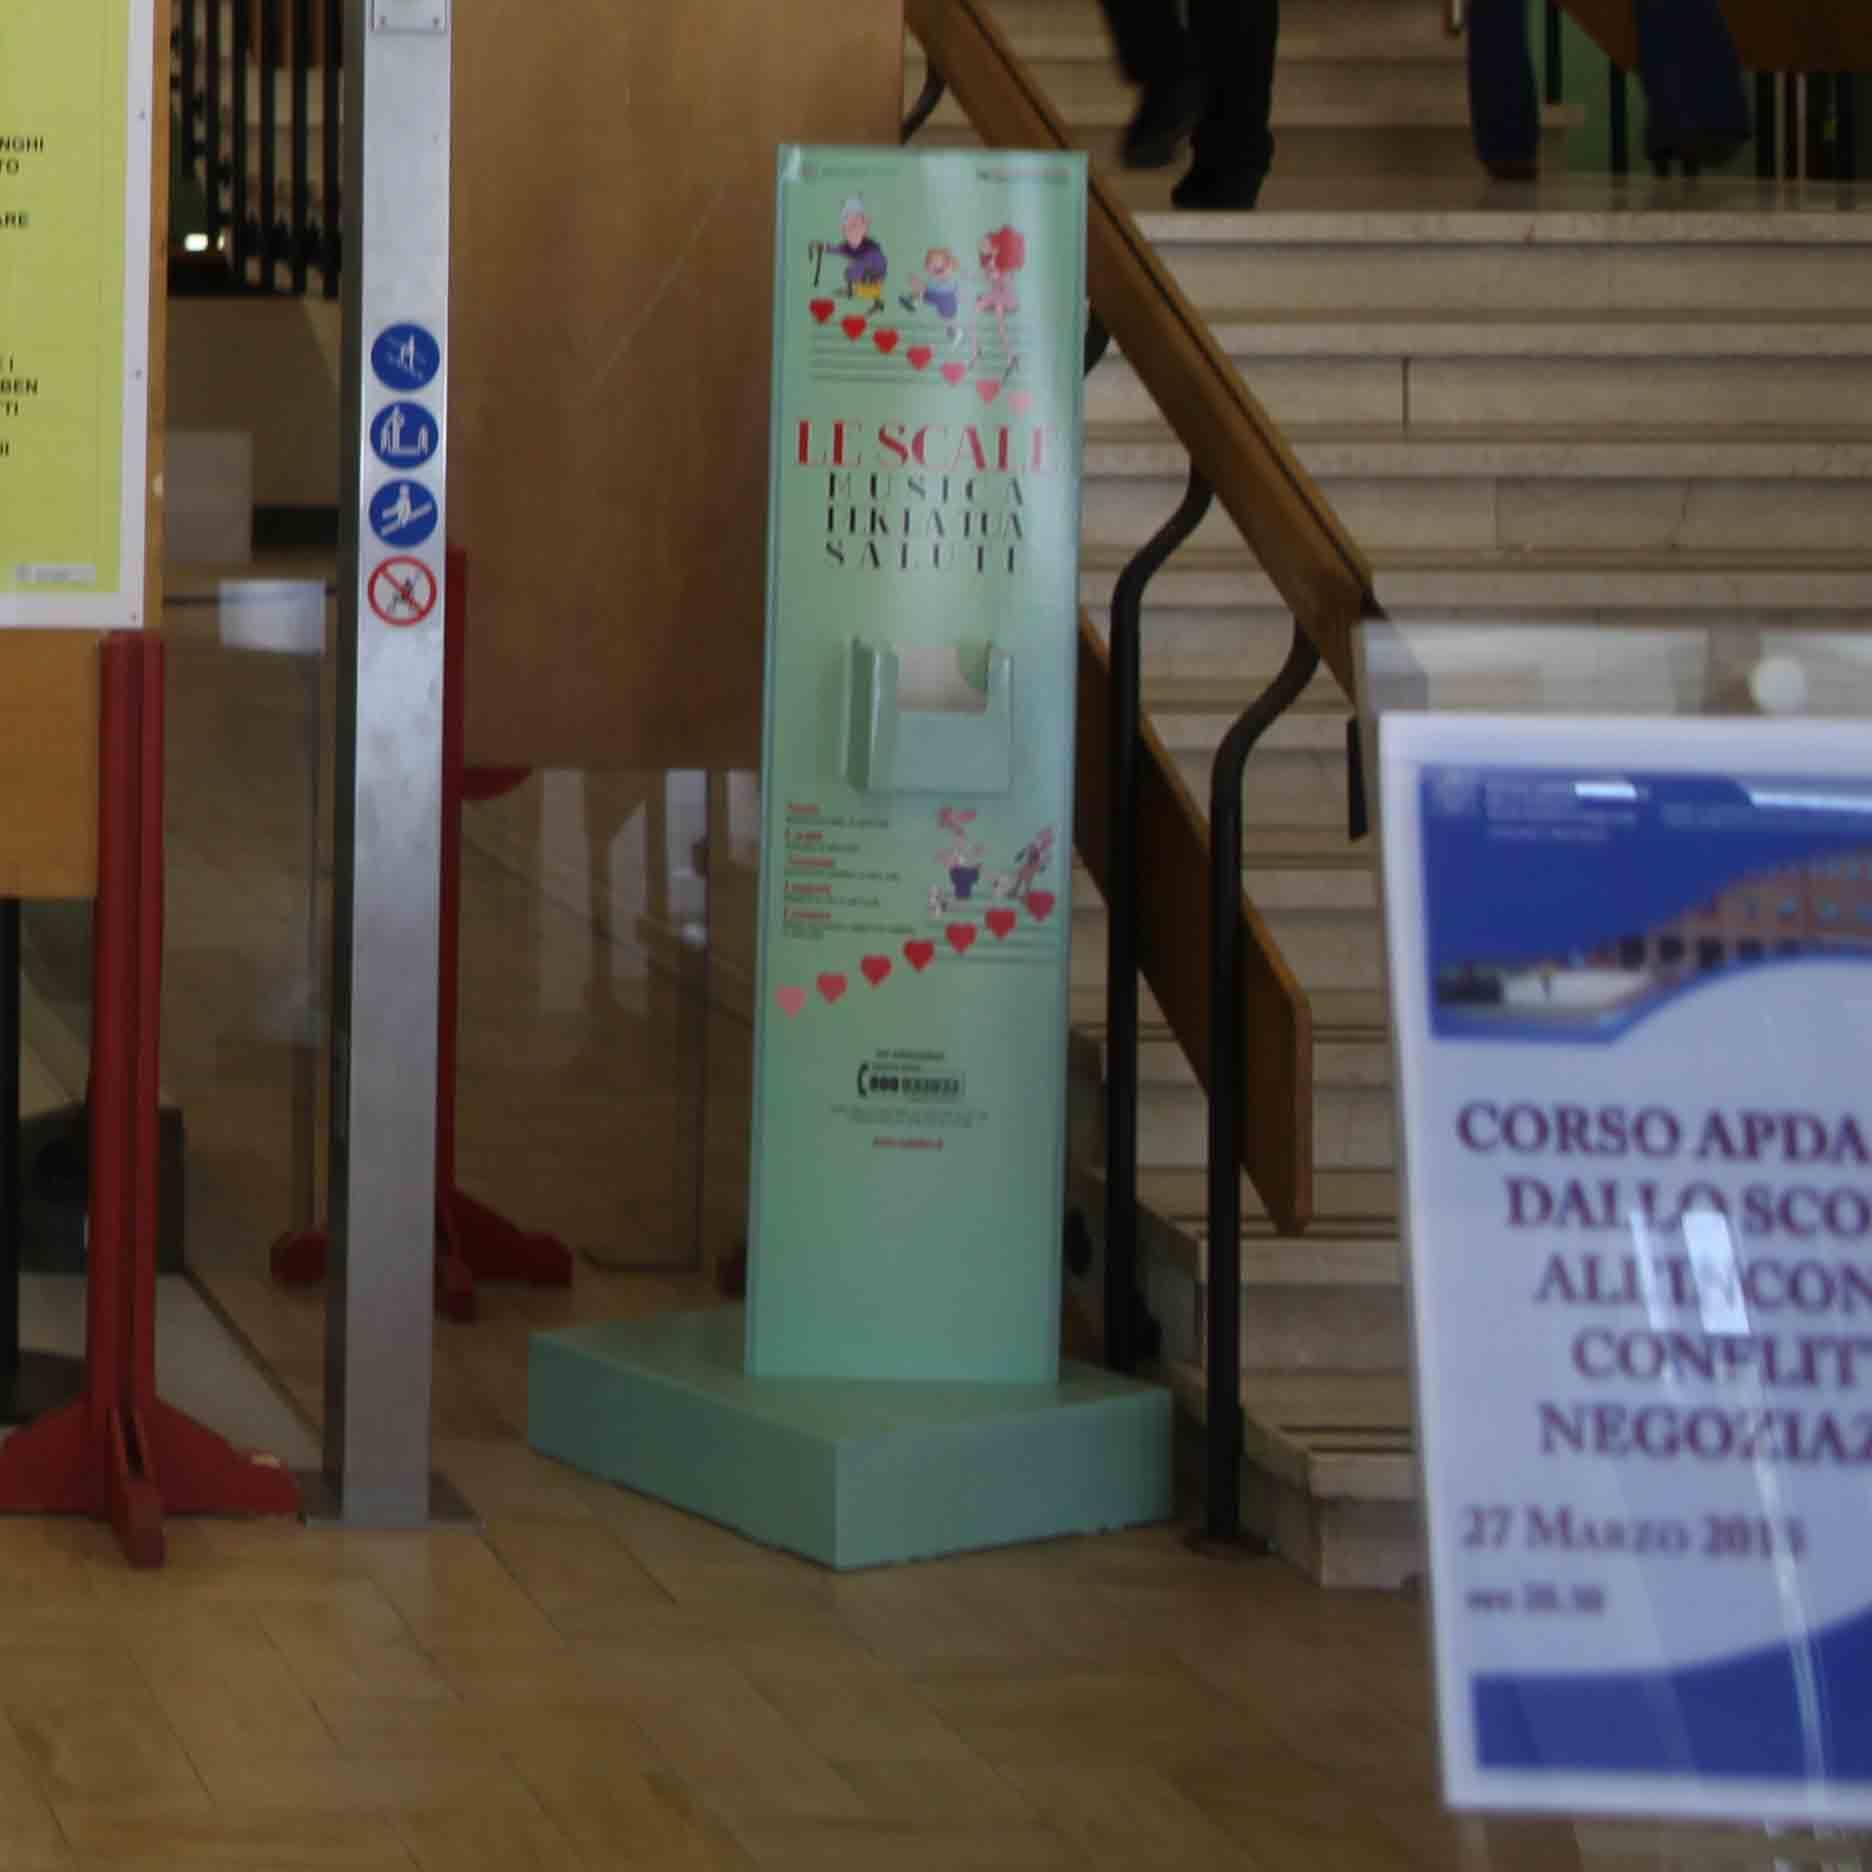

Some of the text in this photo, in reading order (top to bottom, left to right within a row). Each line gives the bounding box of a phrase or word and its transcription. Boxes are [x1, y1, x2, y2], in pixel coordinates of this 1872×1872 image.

[0, 379, 39, 395] BEN
[793, 419, 1055, 472] LE SCALE
[1455, 1102, 1872, 1165] CORSO APDA
[1505, 1175, 1730, 1234] DALLO
